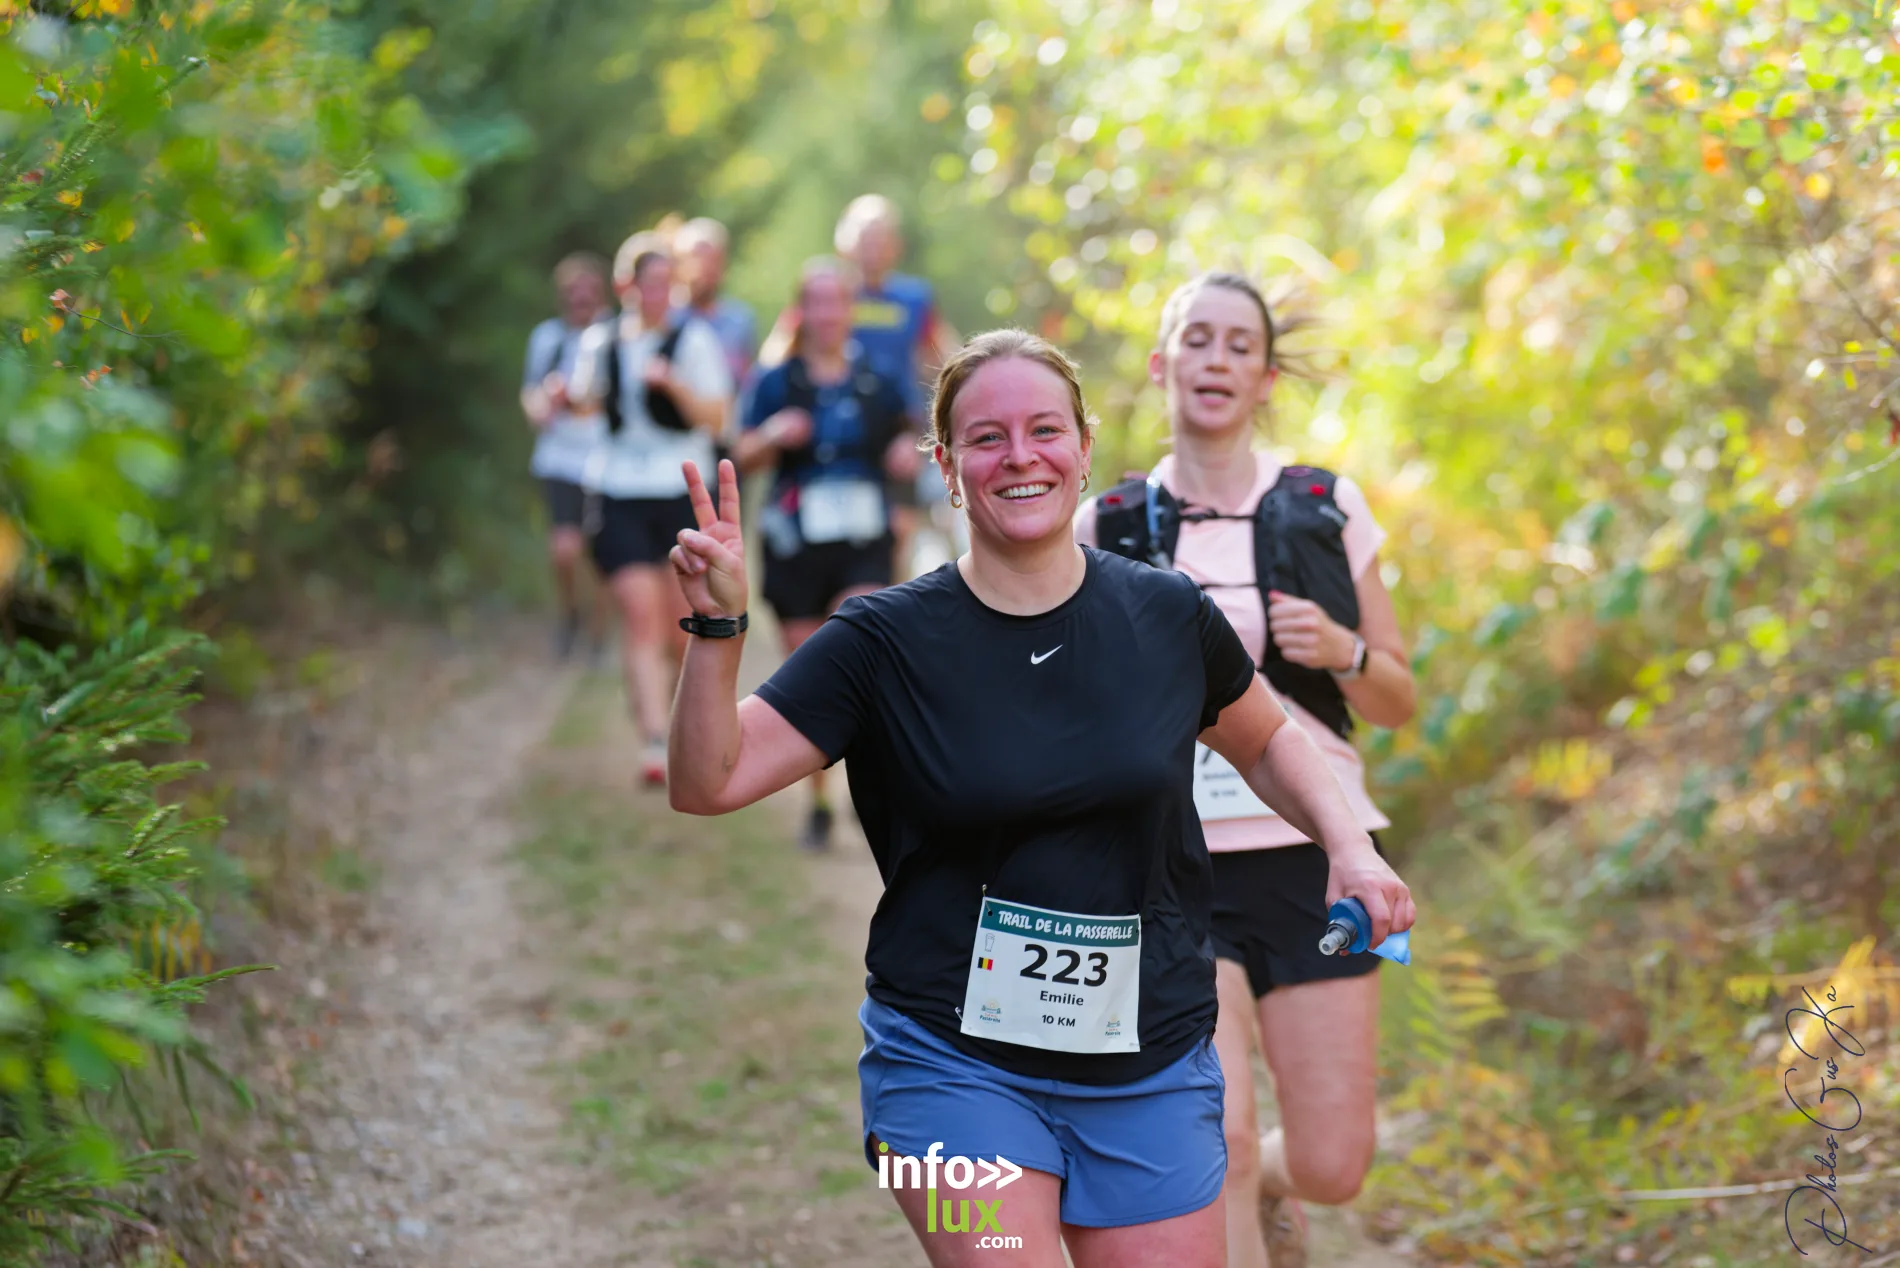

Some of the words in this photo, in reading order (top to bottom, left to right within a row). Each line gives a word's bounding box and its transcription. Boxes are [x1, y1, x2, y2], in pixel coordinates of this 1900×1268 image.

[998, 910, 1033, 930] TRAIL
[1035, 918, 1053, 933] DE
[1054, 922, 1072, 937] LA
[1075, 924, 1133, 941] PASSERELLE
[1019, 943, 1110, 988] 223
[1039, 990, 1085, 1006] Emilie
[1041, 1014, 1055, 1025] 10
[1057, 1016, 1076, 1027] KM
